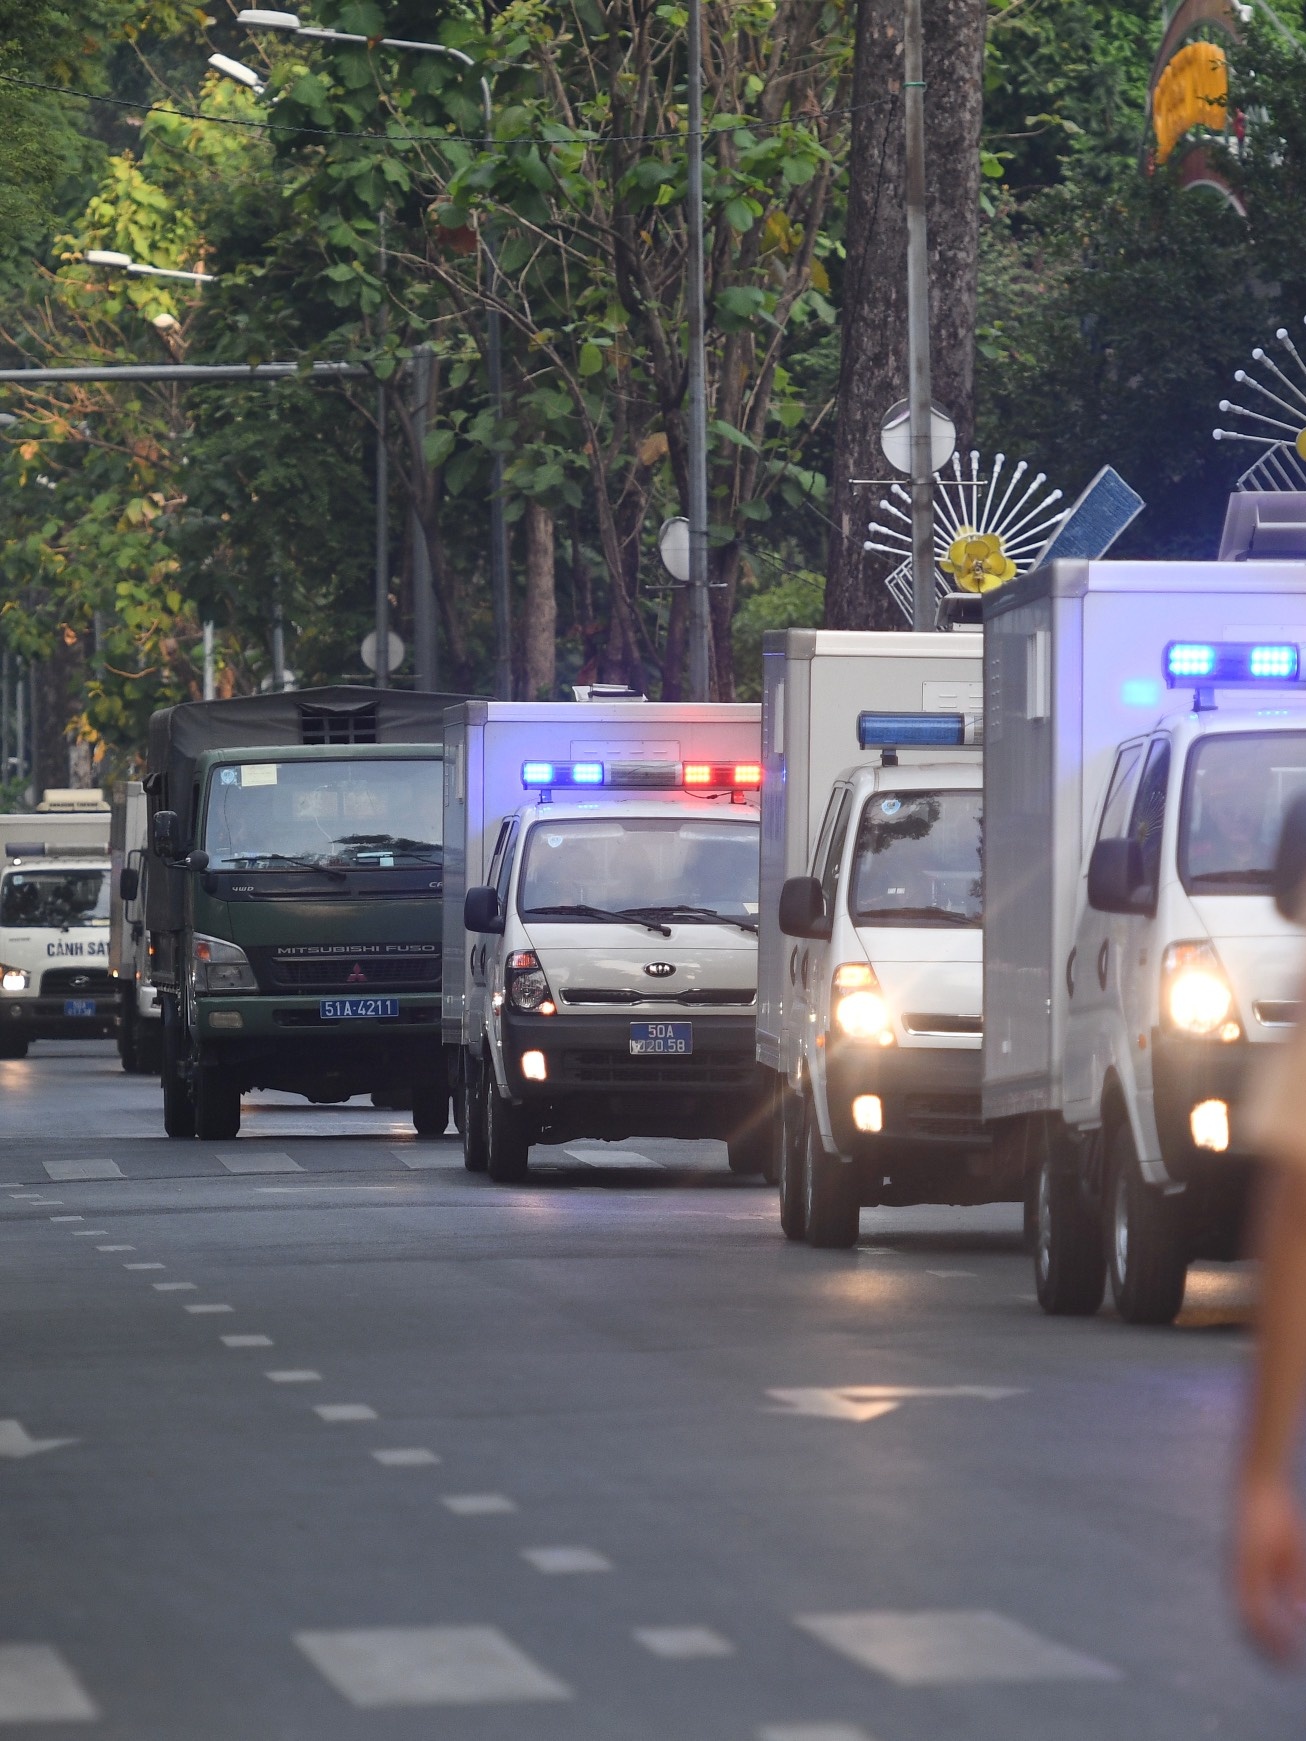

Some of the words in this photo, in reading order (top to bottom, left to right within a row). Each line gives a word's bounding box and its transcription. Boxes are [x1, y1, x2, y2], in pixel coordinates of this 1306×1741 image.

[277, 945, 380, 954] MITSUBISHI
[325, 1000, 392, 1016] 51A-4211
[648, 1024, 674, 1038] 50A
